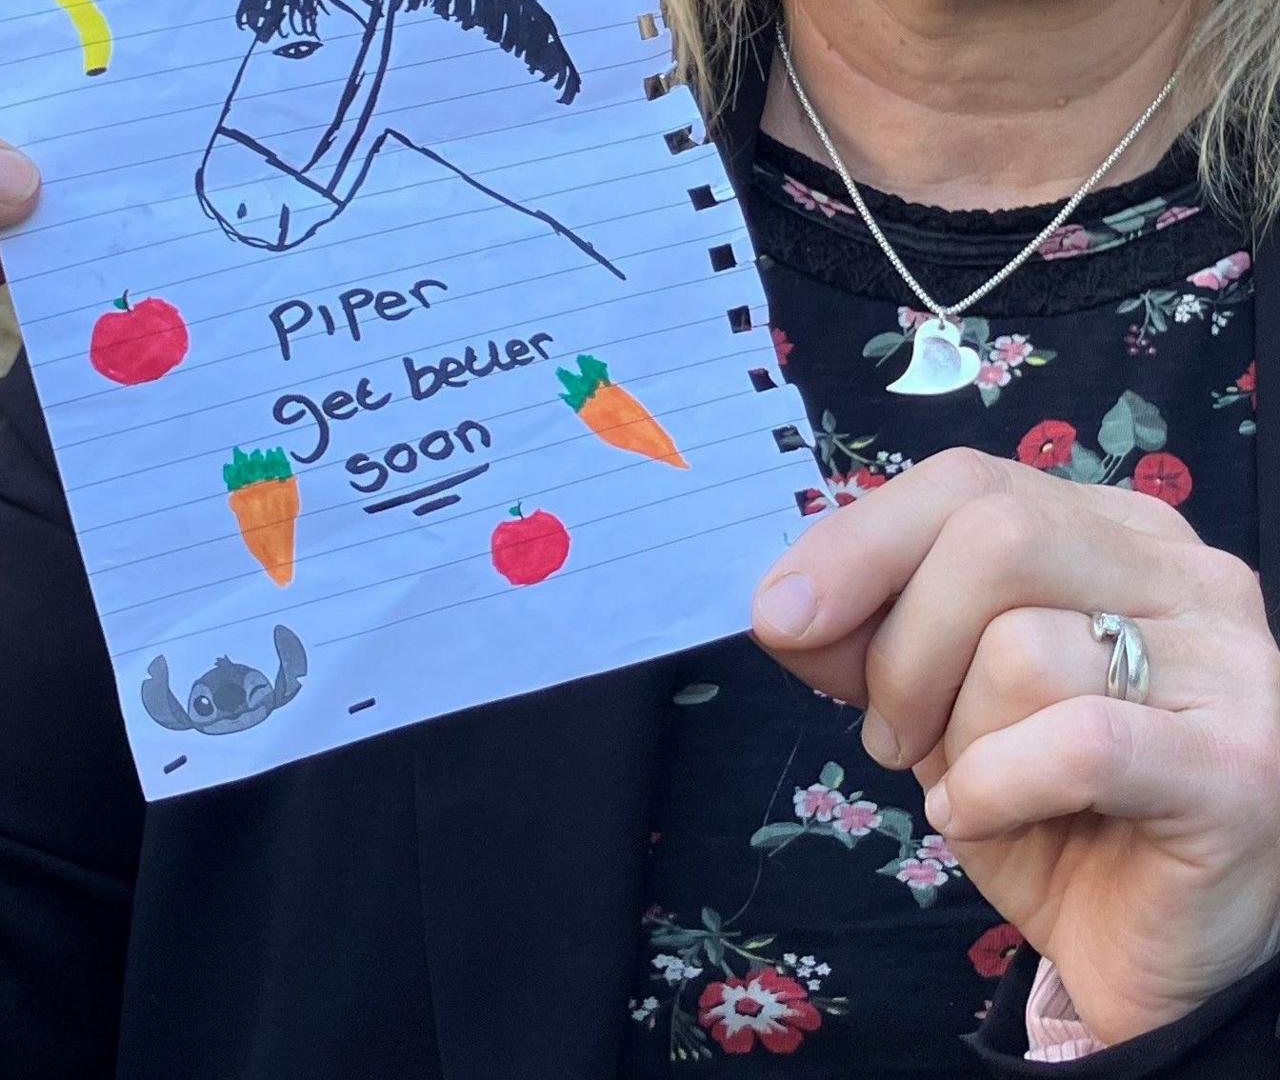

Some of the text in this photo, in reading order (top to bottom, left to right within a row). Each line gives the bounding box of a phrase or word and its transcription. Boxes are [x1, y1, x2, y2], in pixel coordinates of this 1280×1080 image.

[272, 332, 554, 464] get better
[344, 419, 491, 493] soon
